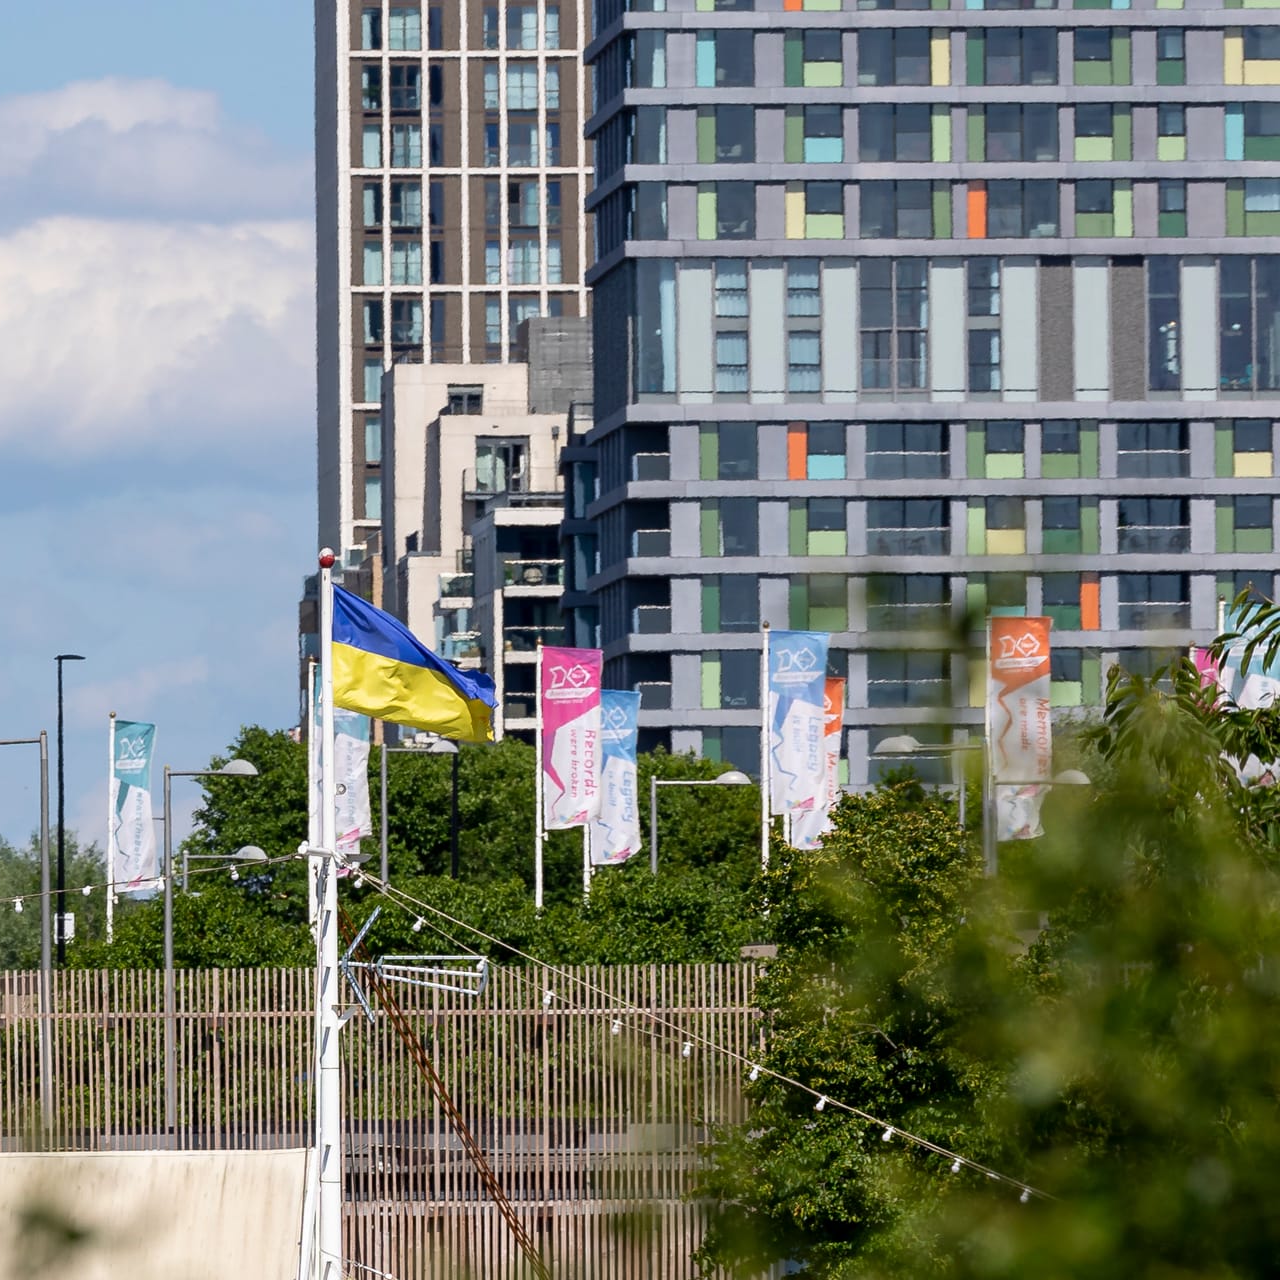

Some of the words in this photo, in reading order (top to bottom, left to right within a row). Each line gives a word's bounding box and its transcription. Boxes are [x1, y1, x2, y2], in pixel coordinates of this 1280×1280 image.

[569, 729, 577, 755] were
[584, 730, 598, 796] Records
[807, 717, 821, 771] Legacy
[1035, 698, 1050, 776] Memories
[570, 760, 580, 798] broken
[621, 771, 634, 822] Legacy
